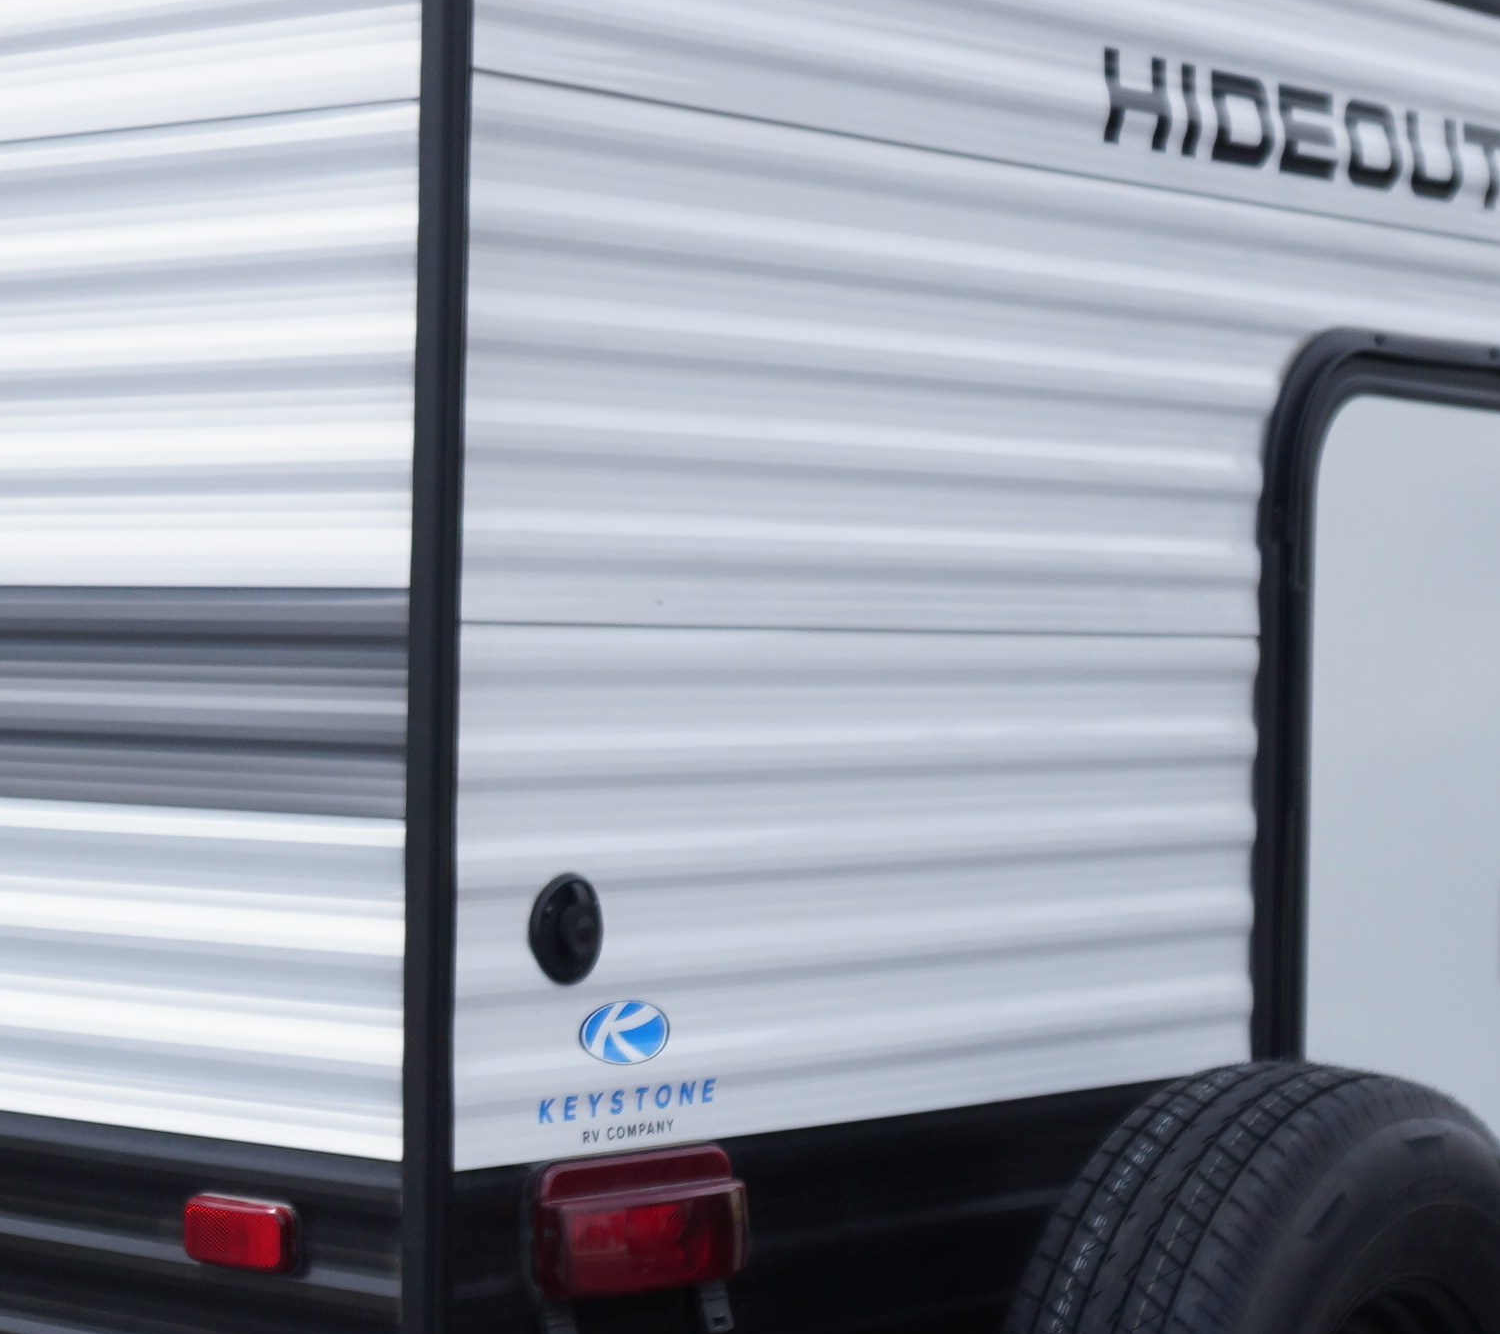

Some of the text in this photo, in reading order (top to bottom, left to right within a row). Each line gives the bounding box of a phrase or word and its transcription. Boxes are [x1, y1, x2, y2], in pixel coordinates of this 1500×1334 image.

[537, 1078, 717, 1125] KEYSTONE
[582, 1118, 675, 1145] RV COMPANY
